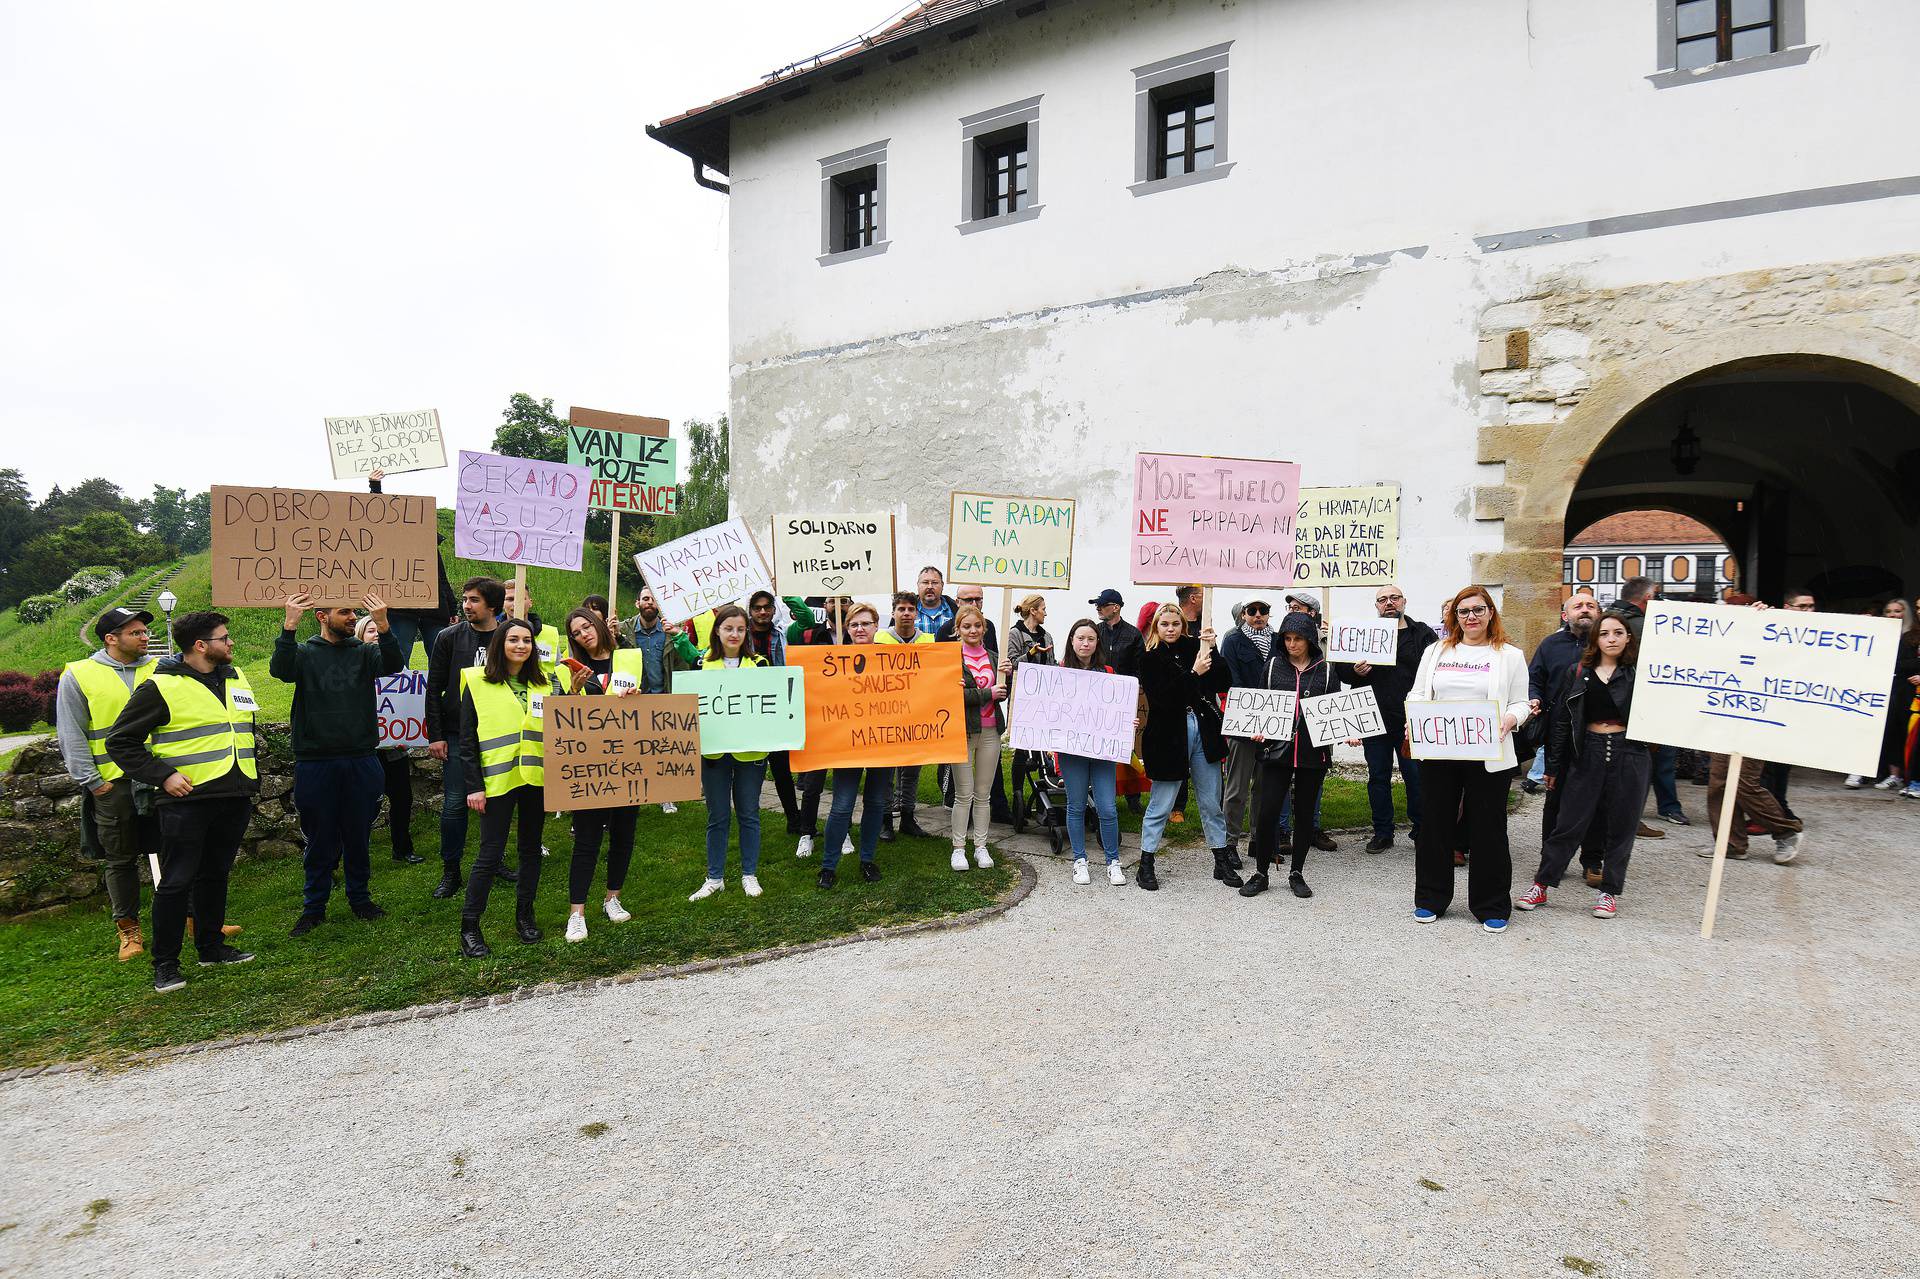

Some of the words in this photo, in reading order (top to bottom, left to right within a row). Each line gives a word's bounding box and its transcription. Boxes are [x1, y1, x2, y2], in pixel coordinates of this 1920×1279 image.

[328, 419, 365, 436] NEMA
[368, 411, 433, 437] JEDNAKOSTI
[336, 438, 367, 457] BEZ
[371, 427, 439, 453] SLOBODE
[569, 425, 623, 459] VAN
[639, 435, 669, 464] IZ
[354, 447, 420, 473] IZBORA!
[585, 456, 650, 485] MOJE
[460, 454, 578, 499] ČEKAMO
[1137, 456, 1197, 501] MOJE
[1214, 468, 1286, 504] TIJELO
[224, 492, 331, 526] DOBRO
[348, 494, 424, 525] DOŠLI
[588, 479, 676, 514] ATERNICE
[460, 499, 509, 527] VAS
[519, 504, 537, 528] U
[545, 506, 574, 535] 21.
[962, 500, 994, 524] NE
[1138, 508, 1170, 534] NE
[1188, 508, 1265, 534] PRIPADA
[1273, 515, 1292, 536] NI
[253, 526, 276, 552] U
[291, 526, 374, 553] GRAD
[788, 519, 878, 536] SOLIDARNO
[992, 528, 1020, 547] NA
[1295, 527, 1308, 542] RA
[1349, 519, 1385, 540] ŽENE
[468, 528, 579, 567] STOLJEĆU
[644, 528, 743, 577] VARAŽDIN
[823, 539, 835, 554] S
[1137, 540, 1208, 568] DRŽAVI
[1218, 547, 1236, 569] NI
[1245, 549, 1294, 573] CRKVI
[1295, 543, 1340, 560] REBALE
[1346, 542, 1379, 558] IMATI
[229, 556, 426, 583] TOLERANCIJE
[656, 582, 686, 601] ZA
[691, 553, 750, 587] PRAVO
[1320, 560, 1341, 579] NA
[1329, 625, 1396, 654] LICEMJERI
[1653, 613, 1735, 637] PRIZIV
[1761, 623, 1876, 657] SAVJESTI
[821, 651, 867, 677] ŠTO
[875, 651, 921, 672] TVOJA
[698, 677, 795, 720] EĆETE!
[1023, 667, 1078, 699] ONAJ
[1087, 674, 1132, 705] KOJI
[1649, 663, 1742, 688] USKRATA
[1763, 676, 1888, 708] MEDICINSKE
[376, 696, 395, 715] A
[822, 704, 850, 722] IMA
[854, 702, 865, 718] S
[868, 699, 912, 716] MOJOM
[1226, 690, 1296, 714] HODATE
[1305, 706, 1315, 720] A
[1317, 689, 1377, 716] GAZITE
[1706, 690, 1769, 714] SKRBI
[553, 706, 640, 732] NISAM
[651, 709, 699, 733] KRIVA
[851, 708, 951, 747] MATERNICOM?
[1014, 698, 1135, 736] ZABRANJUJE
[1224, 718, 1241, 732] ZA
[1315, 711, 1382, 742] ŽENE!
[1409, 715, 1493, 746] LICEMJERI
[554, 737, 587, 756] ŠTO
[602, 739, 625, 755] JE
[633, 736, 697, 756] DRŽAVA
[1012, 725, 1035, 750] TAJ
[1040, 728, 1062, 750] NE
[560, 758, 644, 780] SEPTIČKA
[655, 761, 696, 777] JAMA
